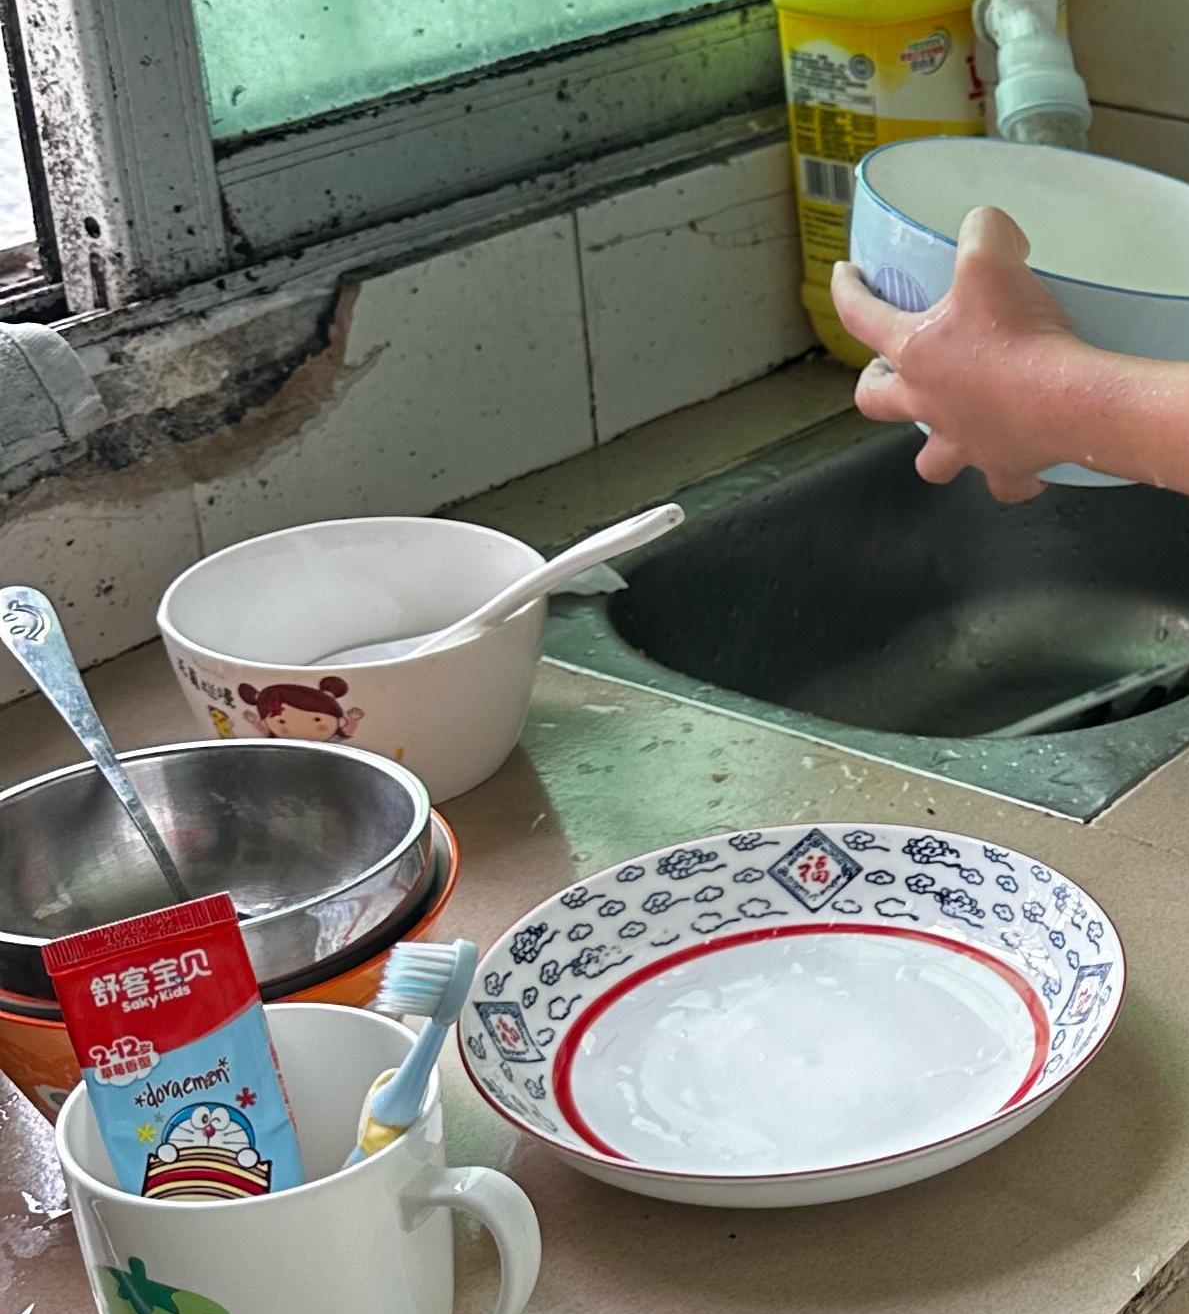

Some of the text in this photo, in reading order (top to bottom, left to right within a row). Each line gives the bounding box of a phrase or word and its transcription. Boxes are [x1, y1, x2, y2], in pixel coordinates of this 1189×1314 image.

[798, 855, 830, 884] 福
[90, 949, 212, 1006] 舒客宝贝
[146, 1068, 231, 1107] doraemon
